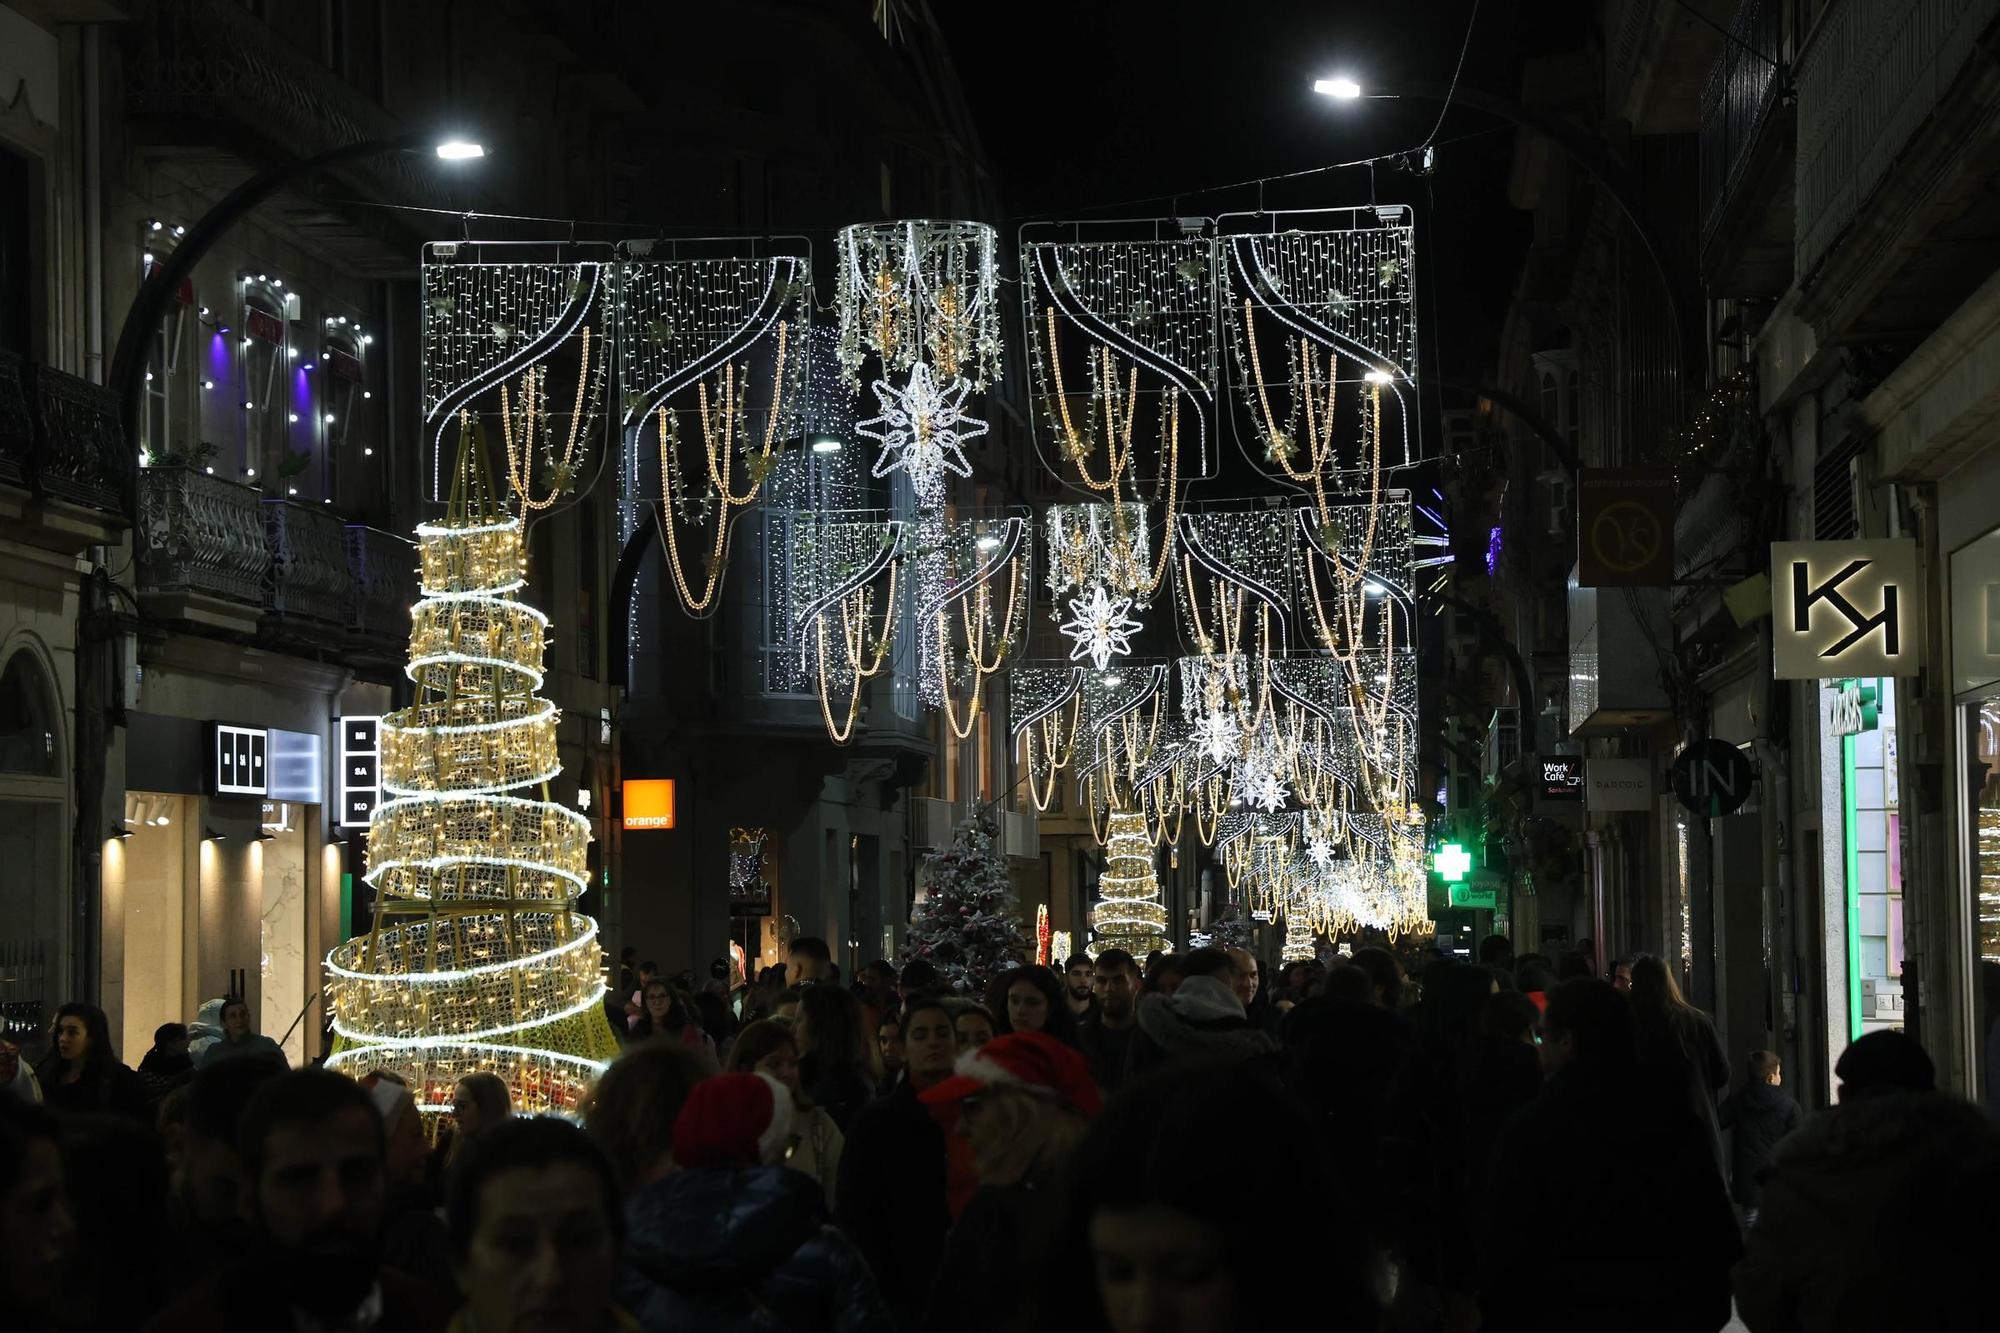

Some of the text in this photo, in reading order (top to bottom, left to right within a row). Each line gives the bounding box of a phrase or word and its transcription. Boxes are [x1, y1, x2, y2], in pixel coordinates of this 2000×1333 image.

[355, 731, 367, 740] MI
[354, 767, 367, 776] SA
[1543, 762, 1568, 772] Work
[1543, 771, 1565, 782] Café
[1690, 759, 1735, 797] IN
[354, 802, 368, 811] KO
[625, 816, 668, 827] orange
